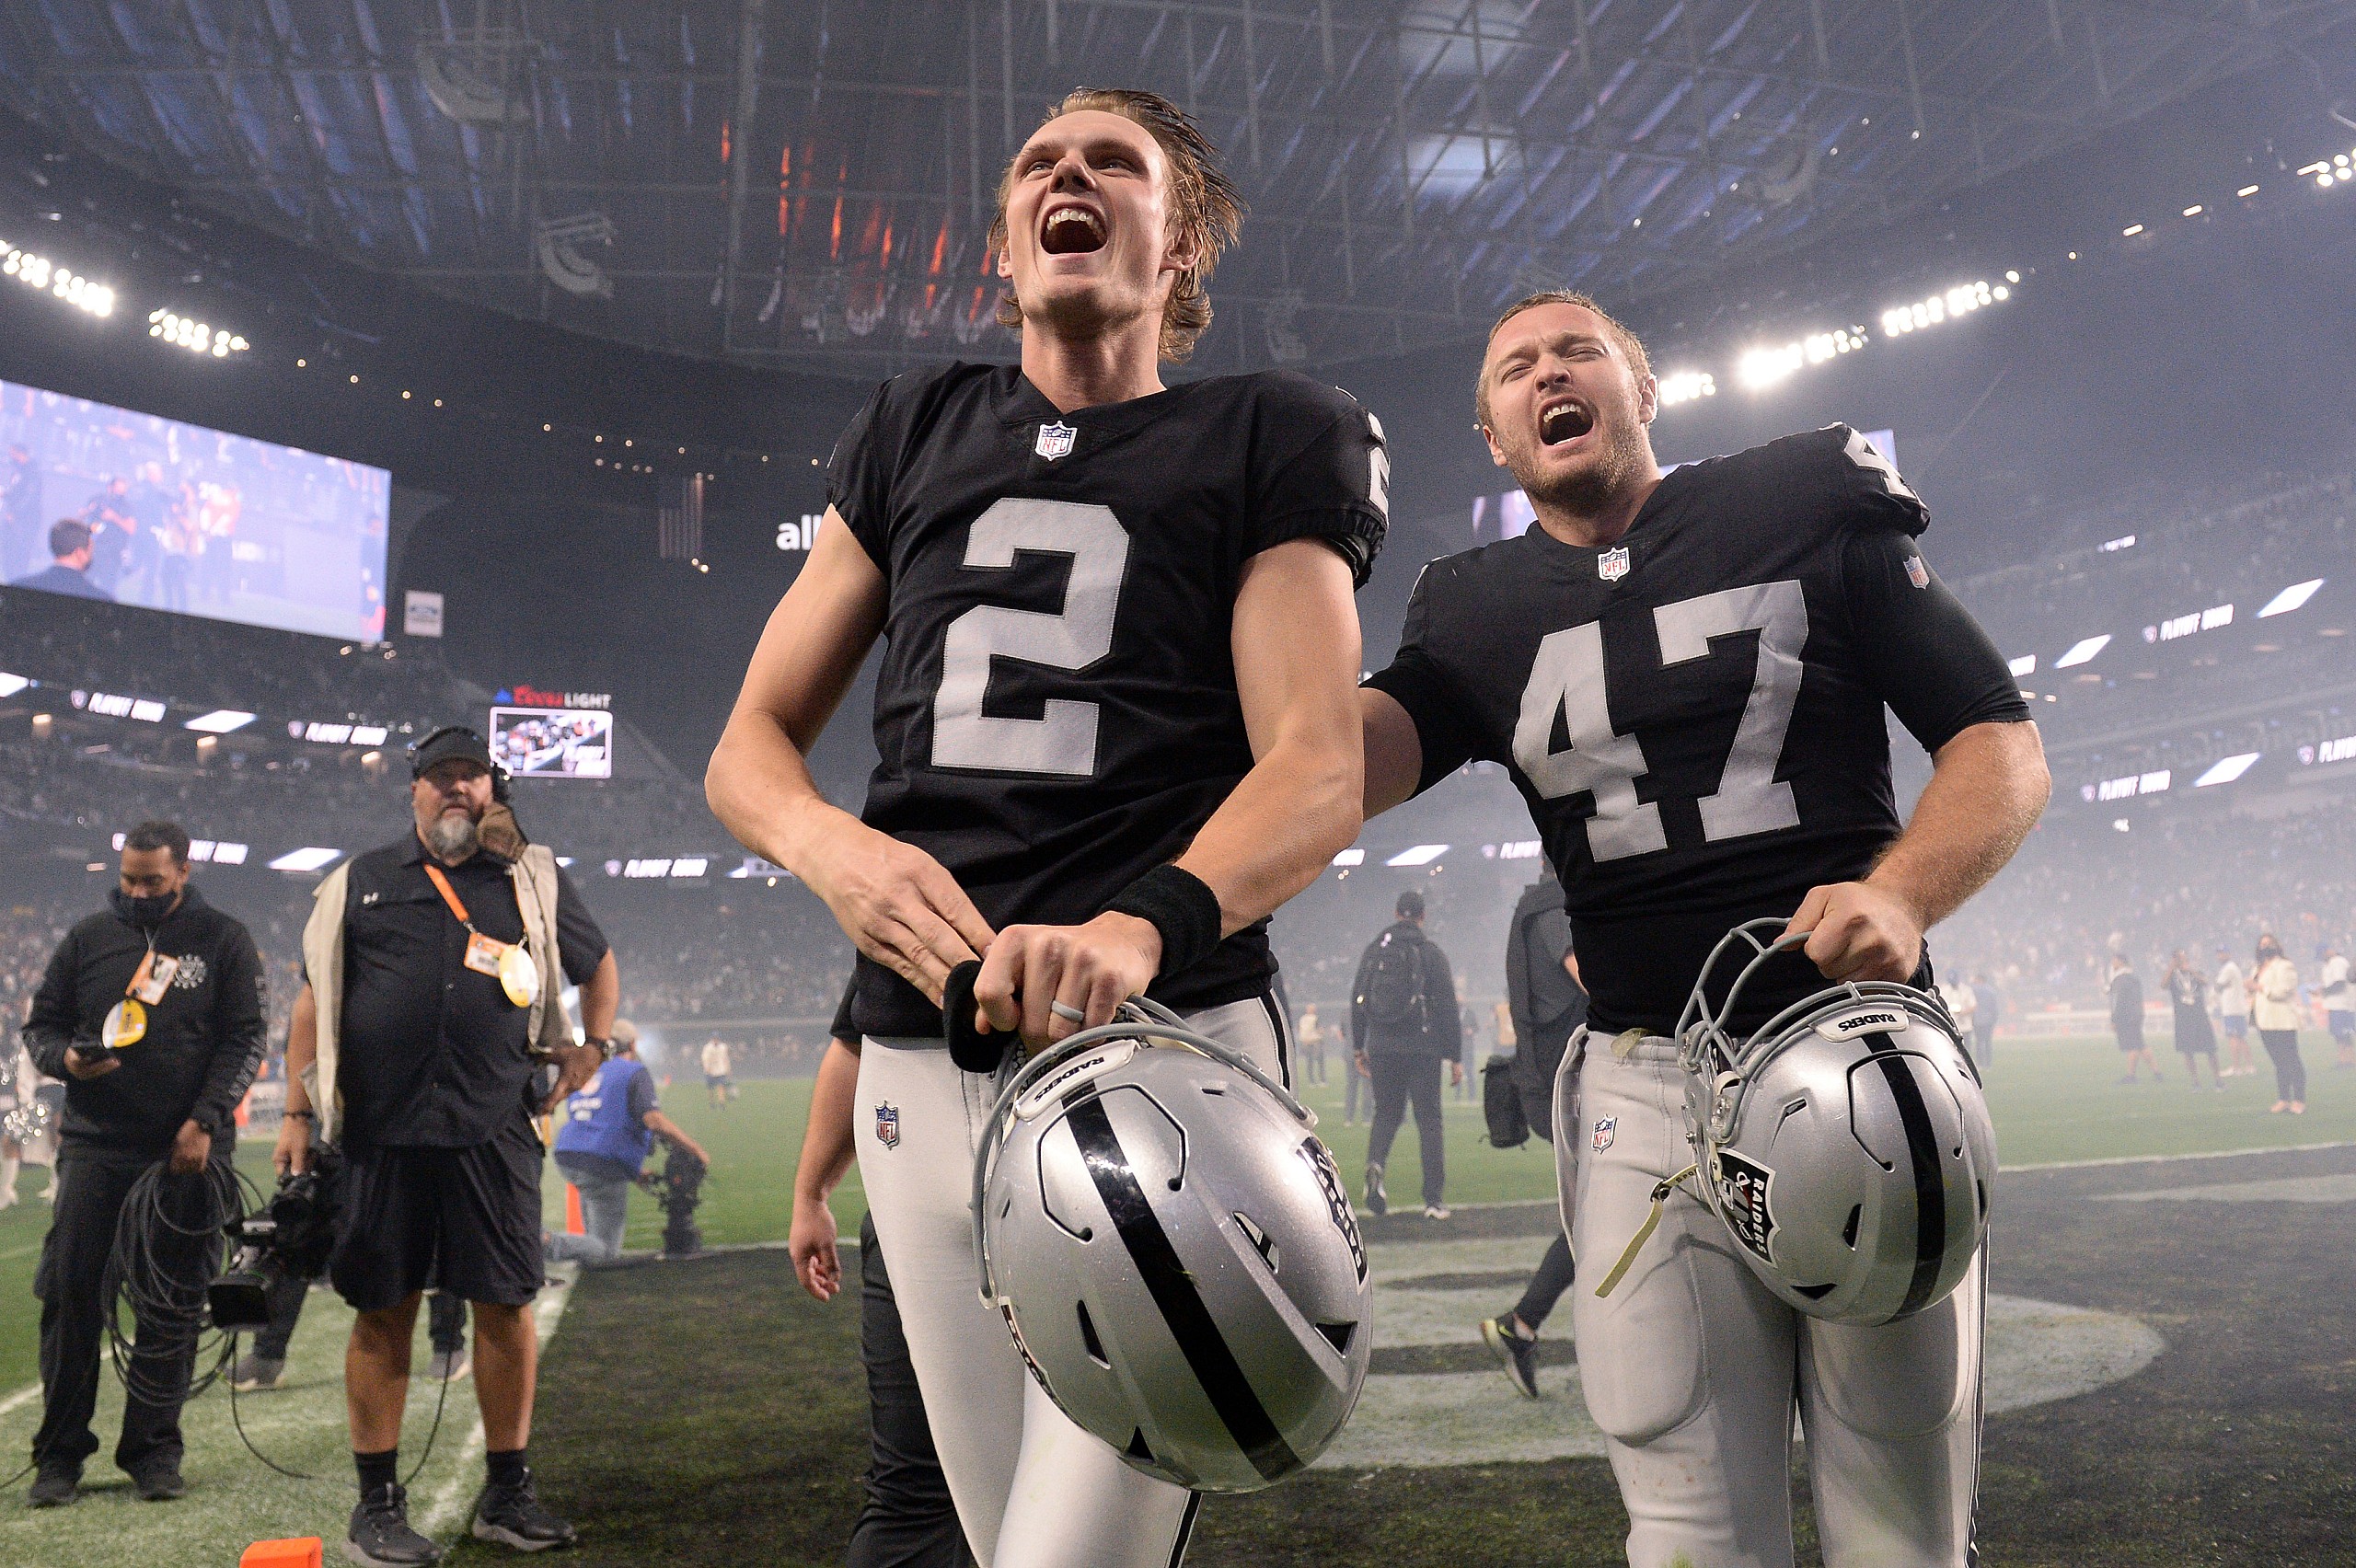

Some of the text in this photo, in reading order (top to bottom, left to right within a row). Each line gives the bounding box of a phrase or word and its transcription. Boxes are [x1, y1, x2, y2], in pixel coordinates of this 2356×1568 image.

[1042, 437, 1068, 453] NFL
[1843, 426, 1930, 513] 4
[1603, 559, 1625, 575] NFL
[930, 497, 1130, 777] 2
[563, 692, 612, 709] LIGHT
[1511, 579, 1809, 863] 47
[1838, 1013, 1898, 1032] RAIDERS
[1034, 1056, 1105, 1102] RAIDERS
[879, 1122, 896, 1141] NFL
[1752, 1177, 1768, 1254] RAIDERS
